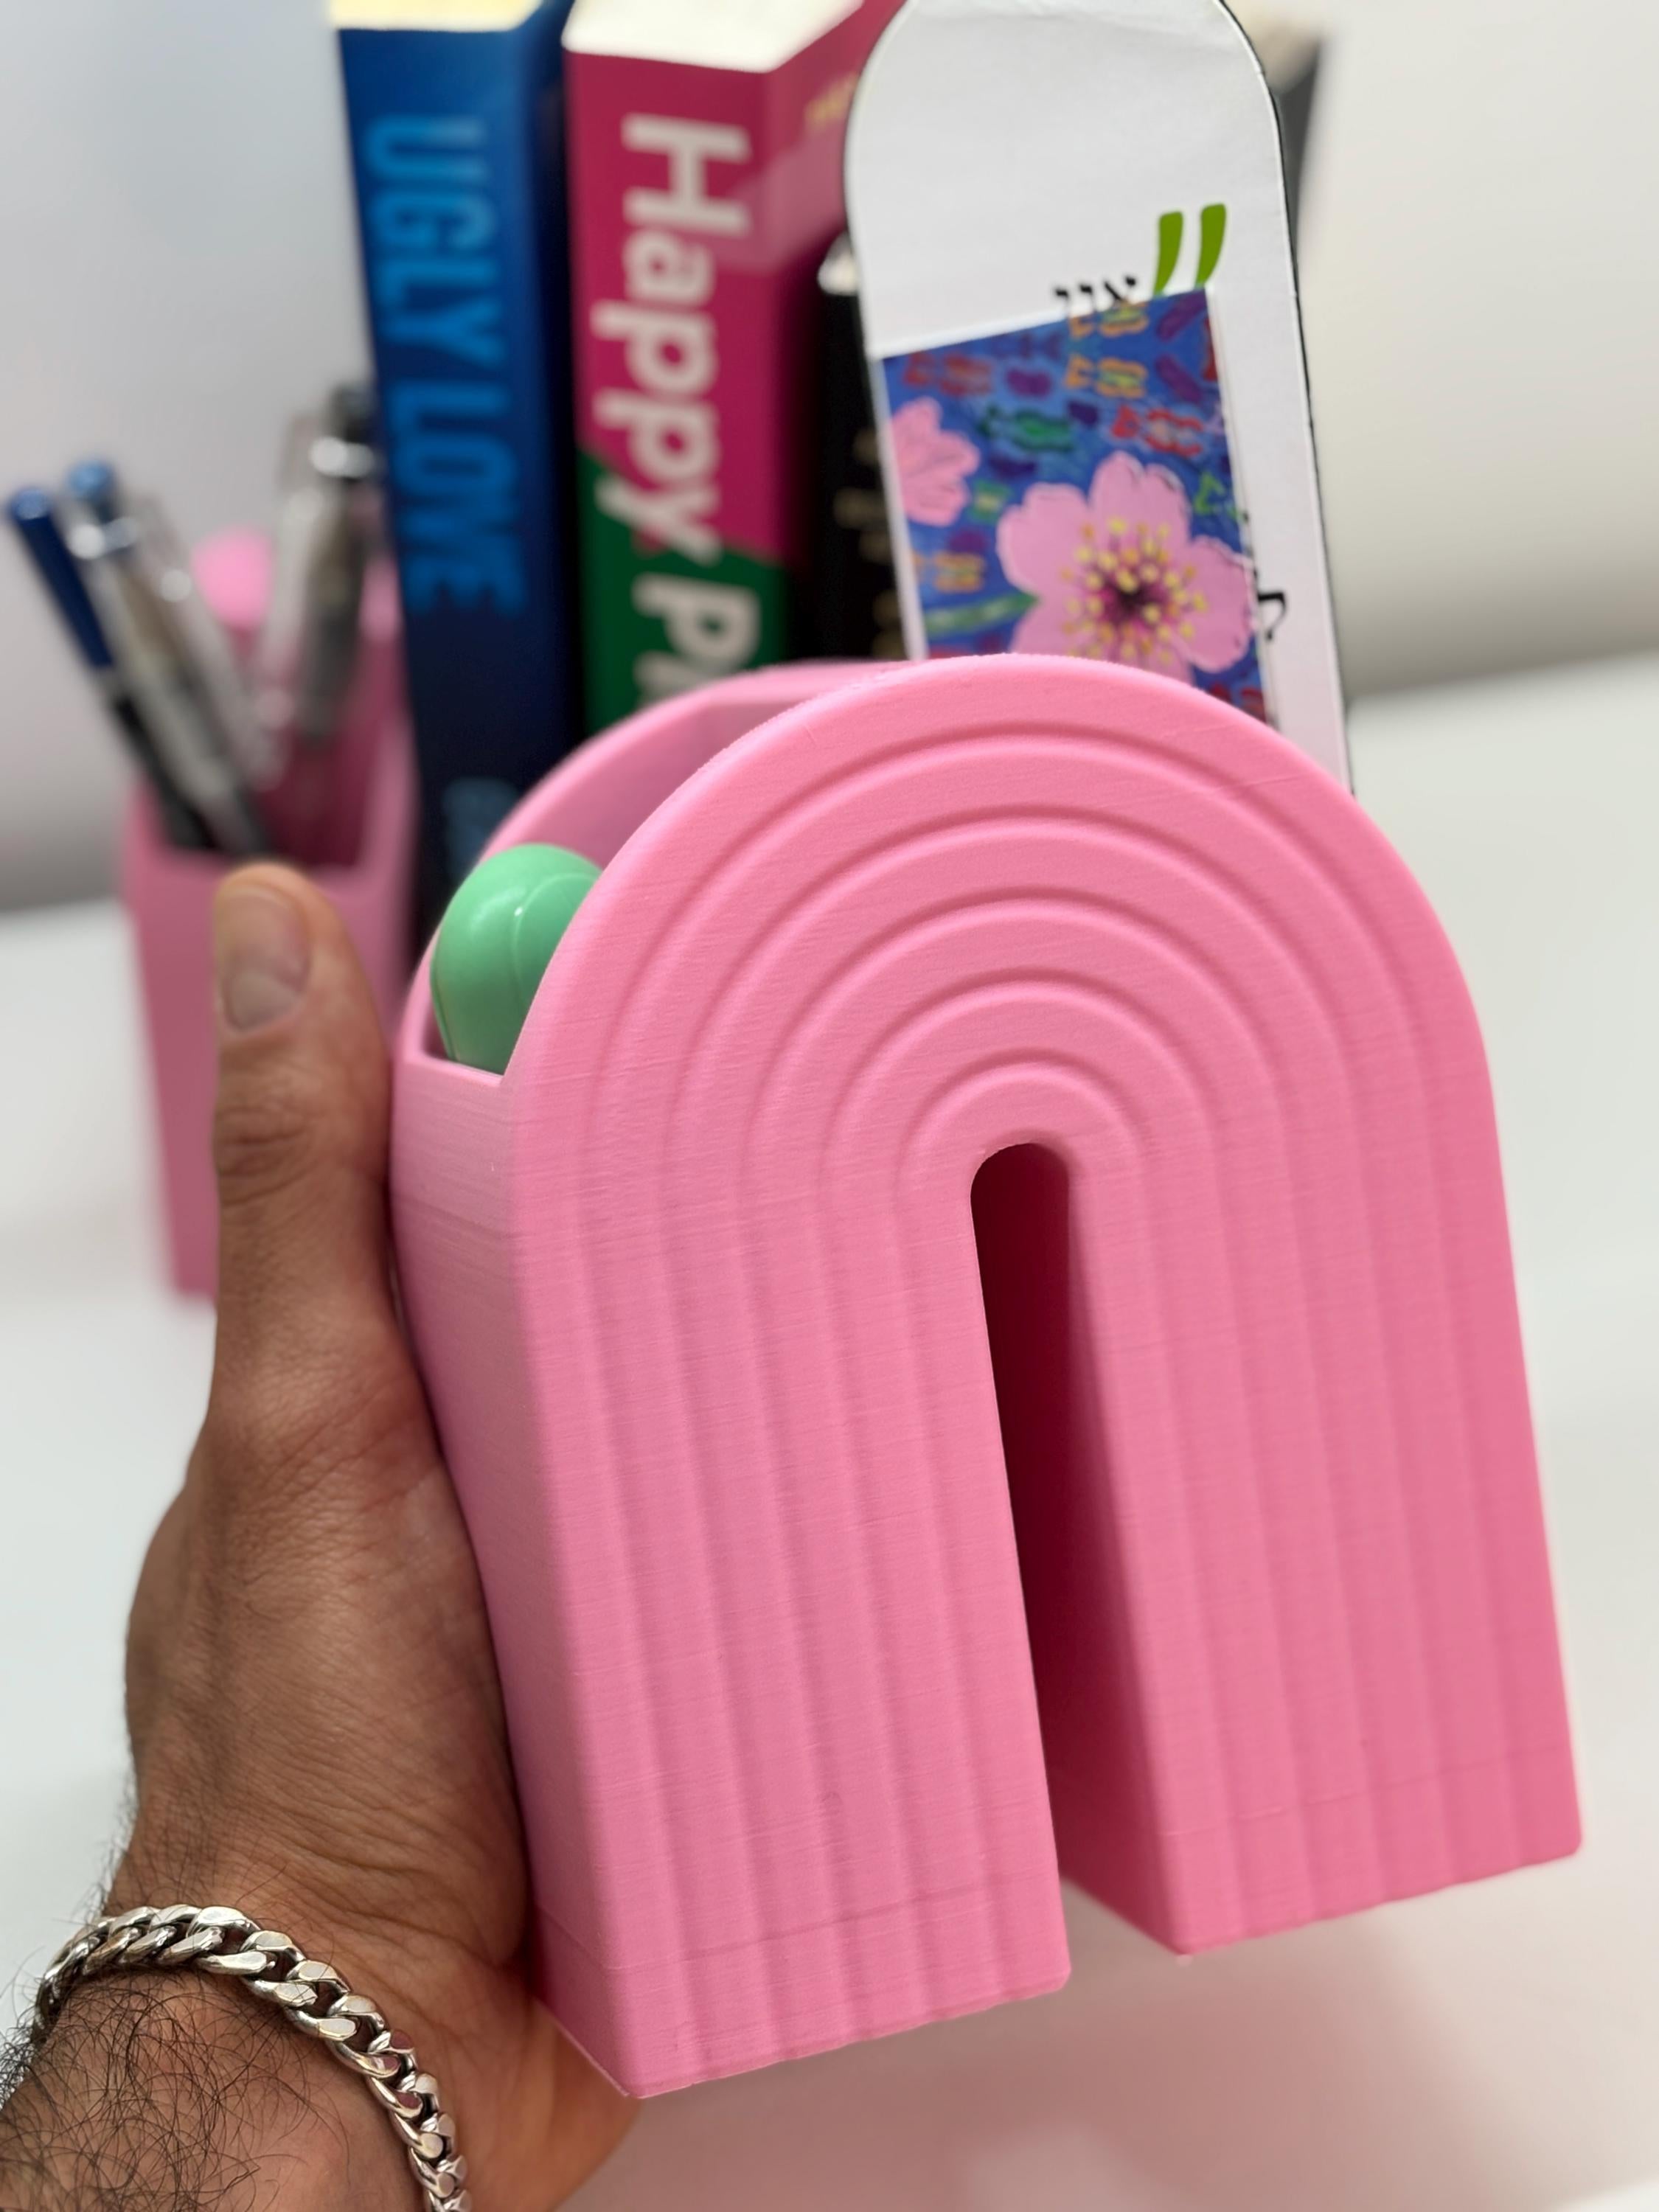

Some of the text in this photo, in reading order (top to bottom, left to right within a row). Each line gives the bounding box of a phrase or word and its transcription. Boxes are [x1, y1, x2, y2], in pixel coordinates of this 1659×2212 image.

[366, 114, 504, 367] UGLY
[593, 113, 751, 565] Happy
[386, 380, 526, 616] LOVE
